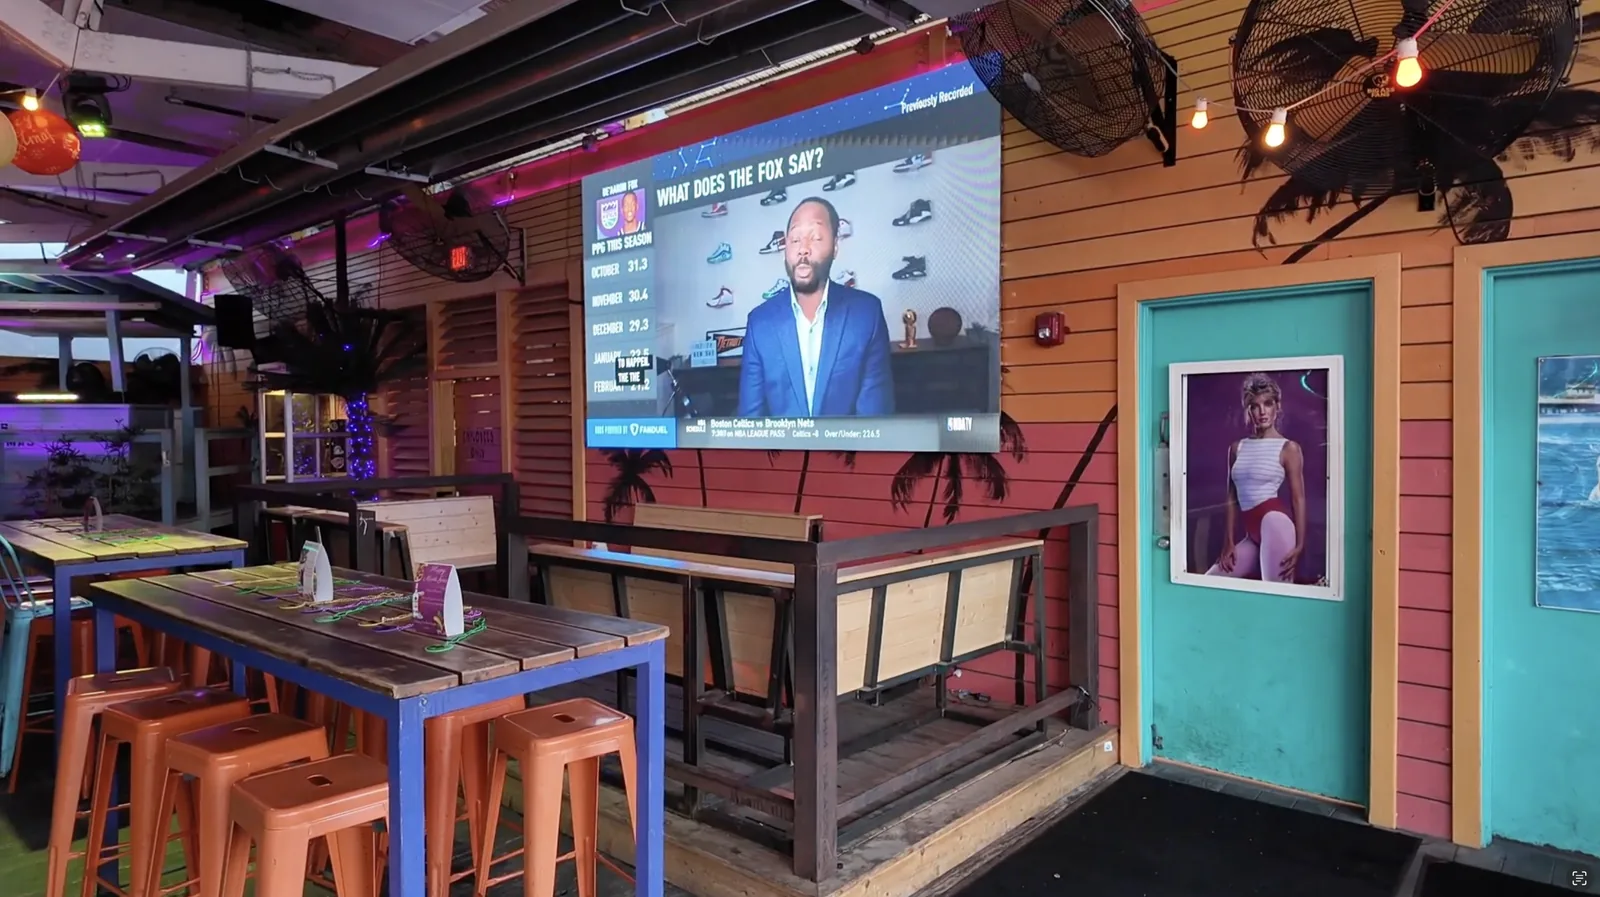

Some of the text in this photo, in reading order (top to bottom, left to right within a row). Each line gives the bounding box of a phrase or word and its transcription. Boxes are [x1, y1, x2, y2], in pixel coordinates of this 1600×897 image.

[901, 84, 973, 114] Previously Recorded
[657, 147, 824, 207] WHAT DOES THE FOX SAY?
[592, 231, 653, 255] PPG THIS SEASON
[591, 258, 648, 279] OCTOBER 31.3
[592, 288, 648, 307] NOVEMBER 30.4
[593, 318, 649, 336] DECEMBER 29.3
[618, 358, 625, 368] TO
[618, 371, 640, 382] THE THE
[640, 426, 668, 434] FANDUEL
[710, 419, 732, 428] Boston
[733, 418, 755, 428] Celtics
[765, 418, 796, 429] Brooklyn
[797, 418, 815, 428] Nets
[734, 430, 746, 438] NBA
[747, 430, 768, 438] LEAGUE
[770, 430, 786, 438] PASS
[792, 430, 812, 438] Celtics
[824, 430, 861, 438] Over/Under:
[862, 430, 880, 438] 226.5
